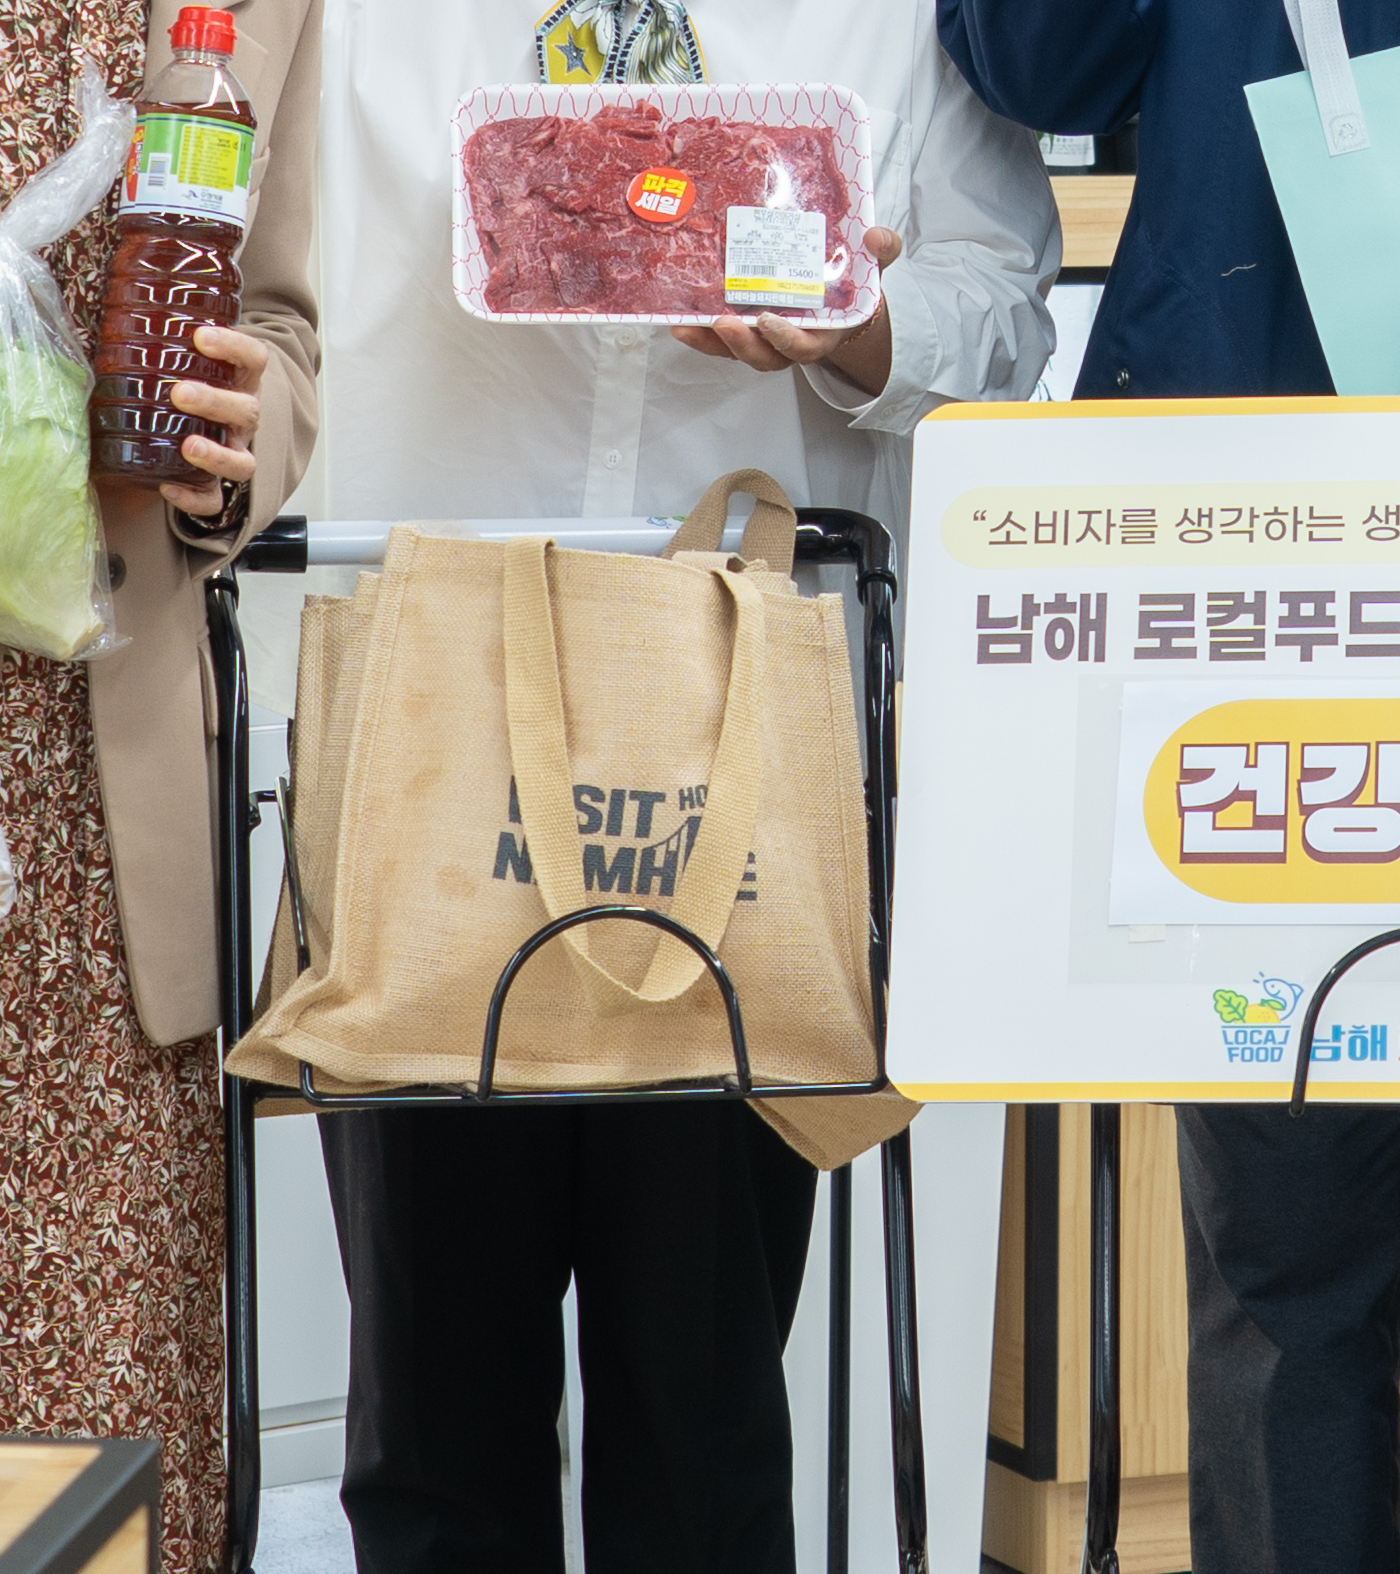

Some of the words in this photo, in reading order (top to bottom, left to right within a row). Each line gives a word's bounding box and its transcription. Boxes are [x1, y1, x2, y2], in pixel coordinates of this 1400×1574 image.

[634, 191, 681, 216] 세일
[642, 173, 687, 198] 파격
[973, 509, 1158, 546] “소비자를
[1175, 506, 1345, 544] 생각하는
[976, 593, 1107, 664] 남해
[509, 775, 666, 839] SIT
[1227, 1046, 1285, 1064] FOOD
[1310, 1025, 1387, 1062] 남해
